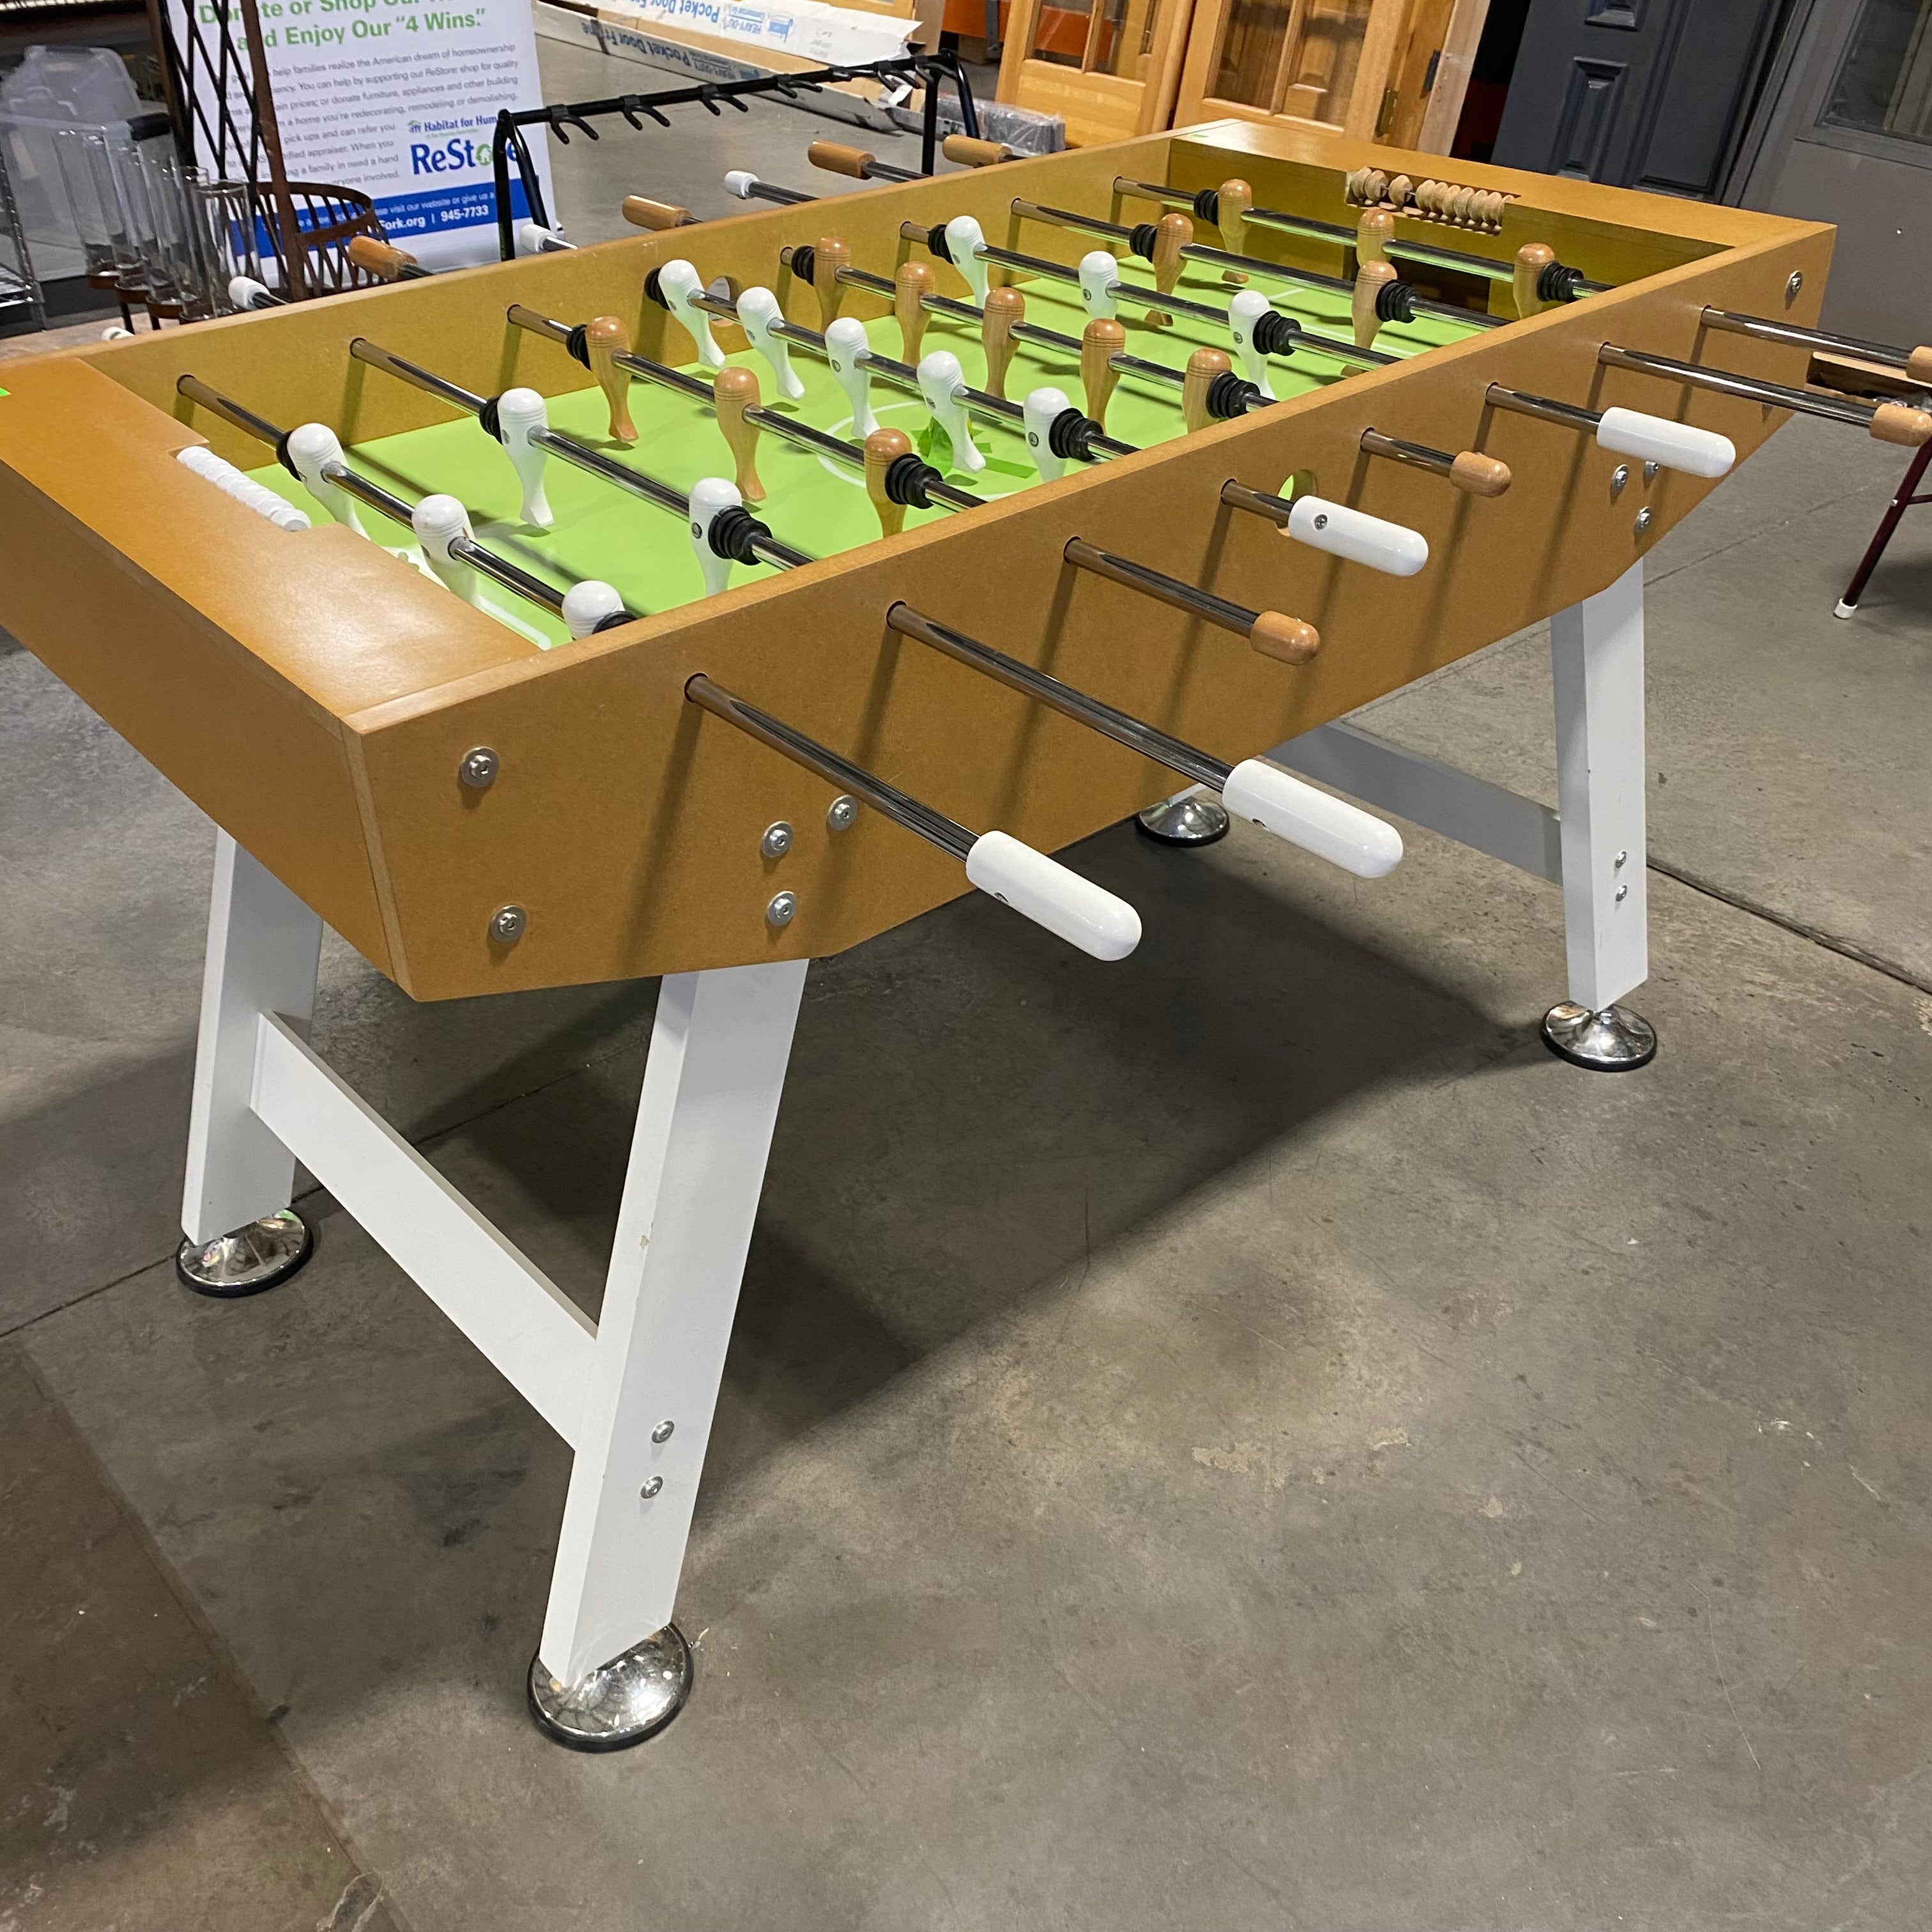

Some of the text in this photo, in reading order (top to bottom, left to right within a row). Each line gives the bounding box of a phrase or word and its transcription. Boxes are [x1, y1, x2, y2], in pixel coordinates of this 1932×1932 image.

[289, 0, 312, 15] or
[321, 0, 376, 13] Shop
[679, 0, 720, 23] Pocket
[236, 29, 277, 50] ad
[286, 24, 345, 47] Enjoy
[352, 19, 391, 38] Our
[293, 65, 327, 74] families
[328, 60, 355, 70] realize
[356, 58, 370, 67] the
[372, 55, 412, 65] American
[413, 52, 440, 61] dream
[441, 49, 450, 57] of
[452, 43, 516, 57] homeownership
[647, 41, 691, 67] Pocket
[333, 78, 351, 87] help
[352, 76, 364, 85] by
[365, 70, 409, 84] supporting
[410, 70, 424, 79] our
[460, 63, 479, 73] shop
[480, 62, 491, 70] for
[493, 59, 518, 71] quality
[331, 94, 360, 104] donate
[402, 84, 445, 96] appliances
[447, 82, 462, 91] and
[464, 80, 484, 89] other
[487, 75, 518, 86] building
[456, 98, 464, 106] or
[322, 130, 339, 139] and
[379, 124, 395, 133] you
[424, 119, 457, 132] Habitat
[460, 118, 473, 127] for
[350, 141, 376, 151] When
[378, 140, 394, 149] you
[309, 162, 335, 172] family
[348, 158, 369, 167] need
[378, 154, 399, 164] hand
[390, 204, 404, 213] visit
[421, 198, 450, 210] website
[461, 194, 477, 205] give
[441, 204, 489, 222] 945-7733
